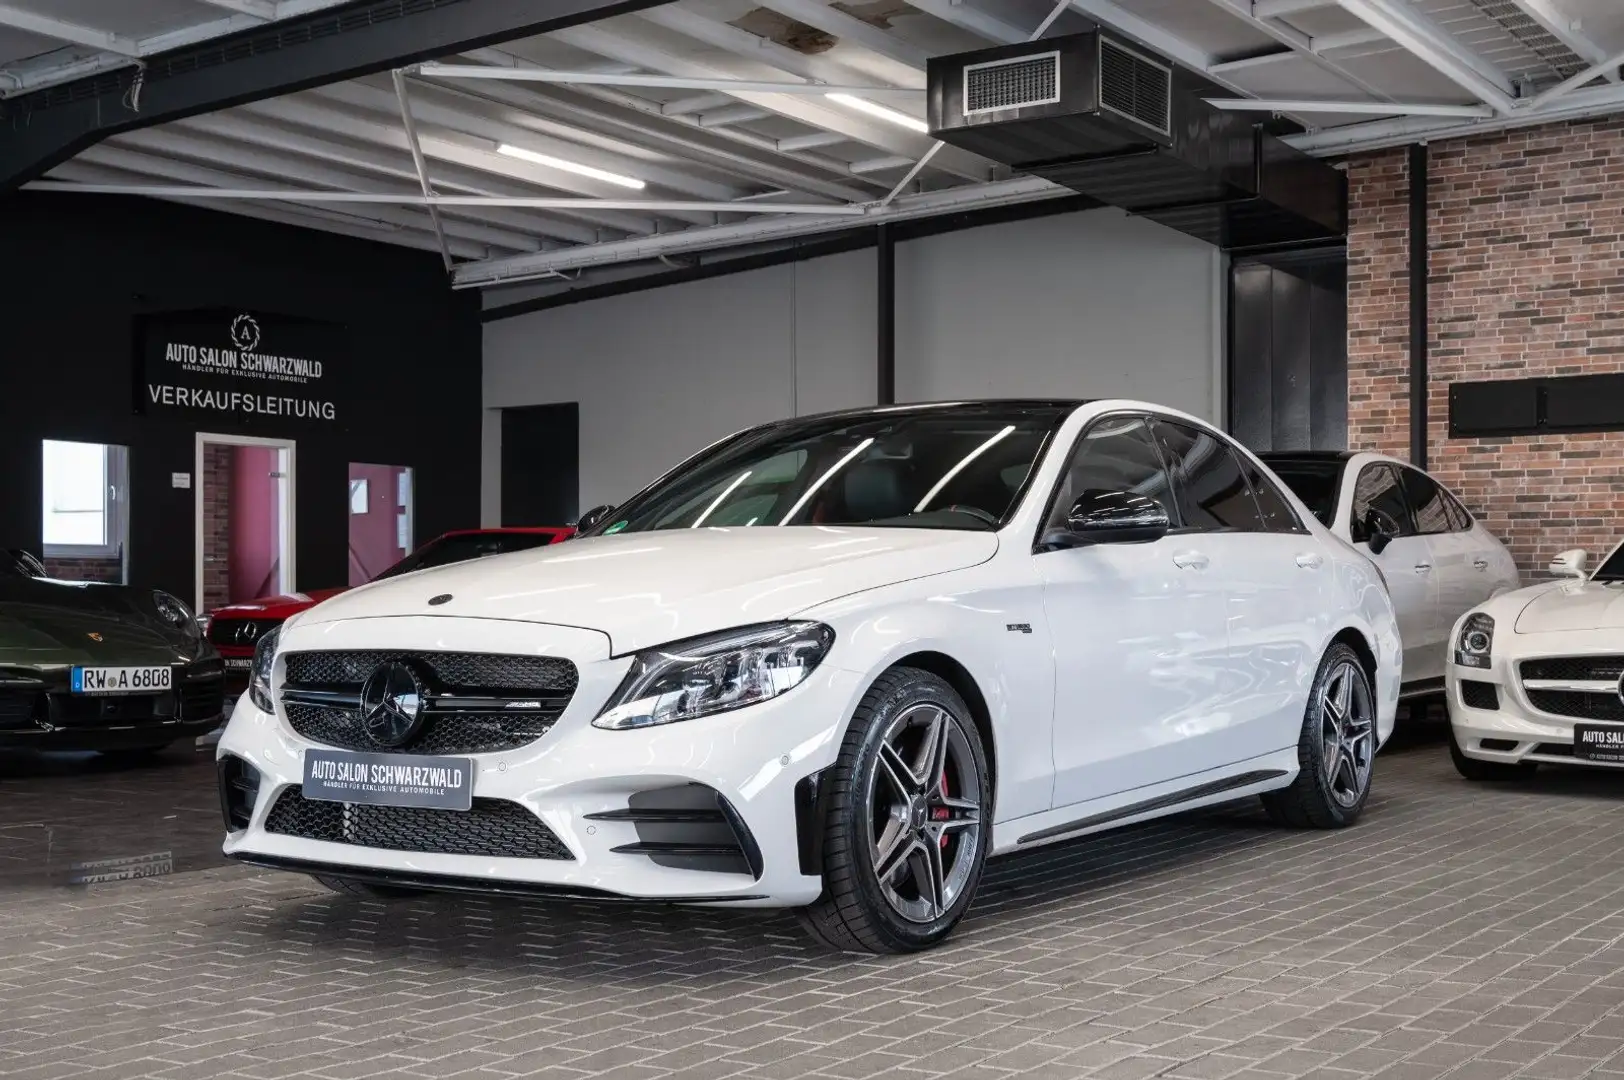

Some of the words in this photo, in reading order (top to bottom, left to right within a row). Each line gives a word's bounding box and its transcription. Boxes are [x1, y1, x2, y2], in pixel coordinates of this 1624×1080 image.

[241, 325, 251, 340] A
[166, 343, 197, 363] AUTO
[200, 347, 237, 369] SALON
[241, 352, 322, 378] SCHWARZWALD
[182, 363, 214, 373] HÄNDLER
[216, 367, 229, 375] FÜR
[231, 369, 266, 379] EXKLUSIVE
[268, 373, 308, 384] AUTOMOBILE
[148, 384, 335, 420] VERKAUFSLEITUNG
[84, 670, 107, 689] RW
[118, 670, 128, 688] A
[132, 668, 170, 688] 6808
[1582, 730, 1605, 743] AUTO
[1606, 731, 1624, 744] SAL
[312, 760, 336, 780] AUTO
[337, 762, 368, 783] SALON
[371, 764, 462, 788] SCHWARZWALD
[323, 780, 348, 789] HÄNDLER
[349, 782, 360, 790] FÜR
[362, 783, 397, 793] EXKLUSIVE
[400, 786, 445, 796] AUTOMOBILE
